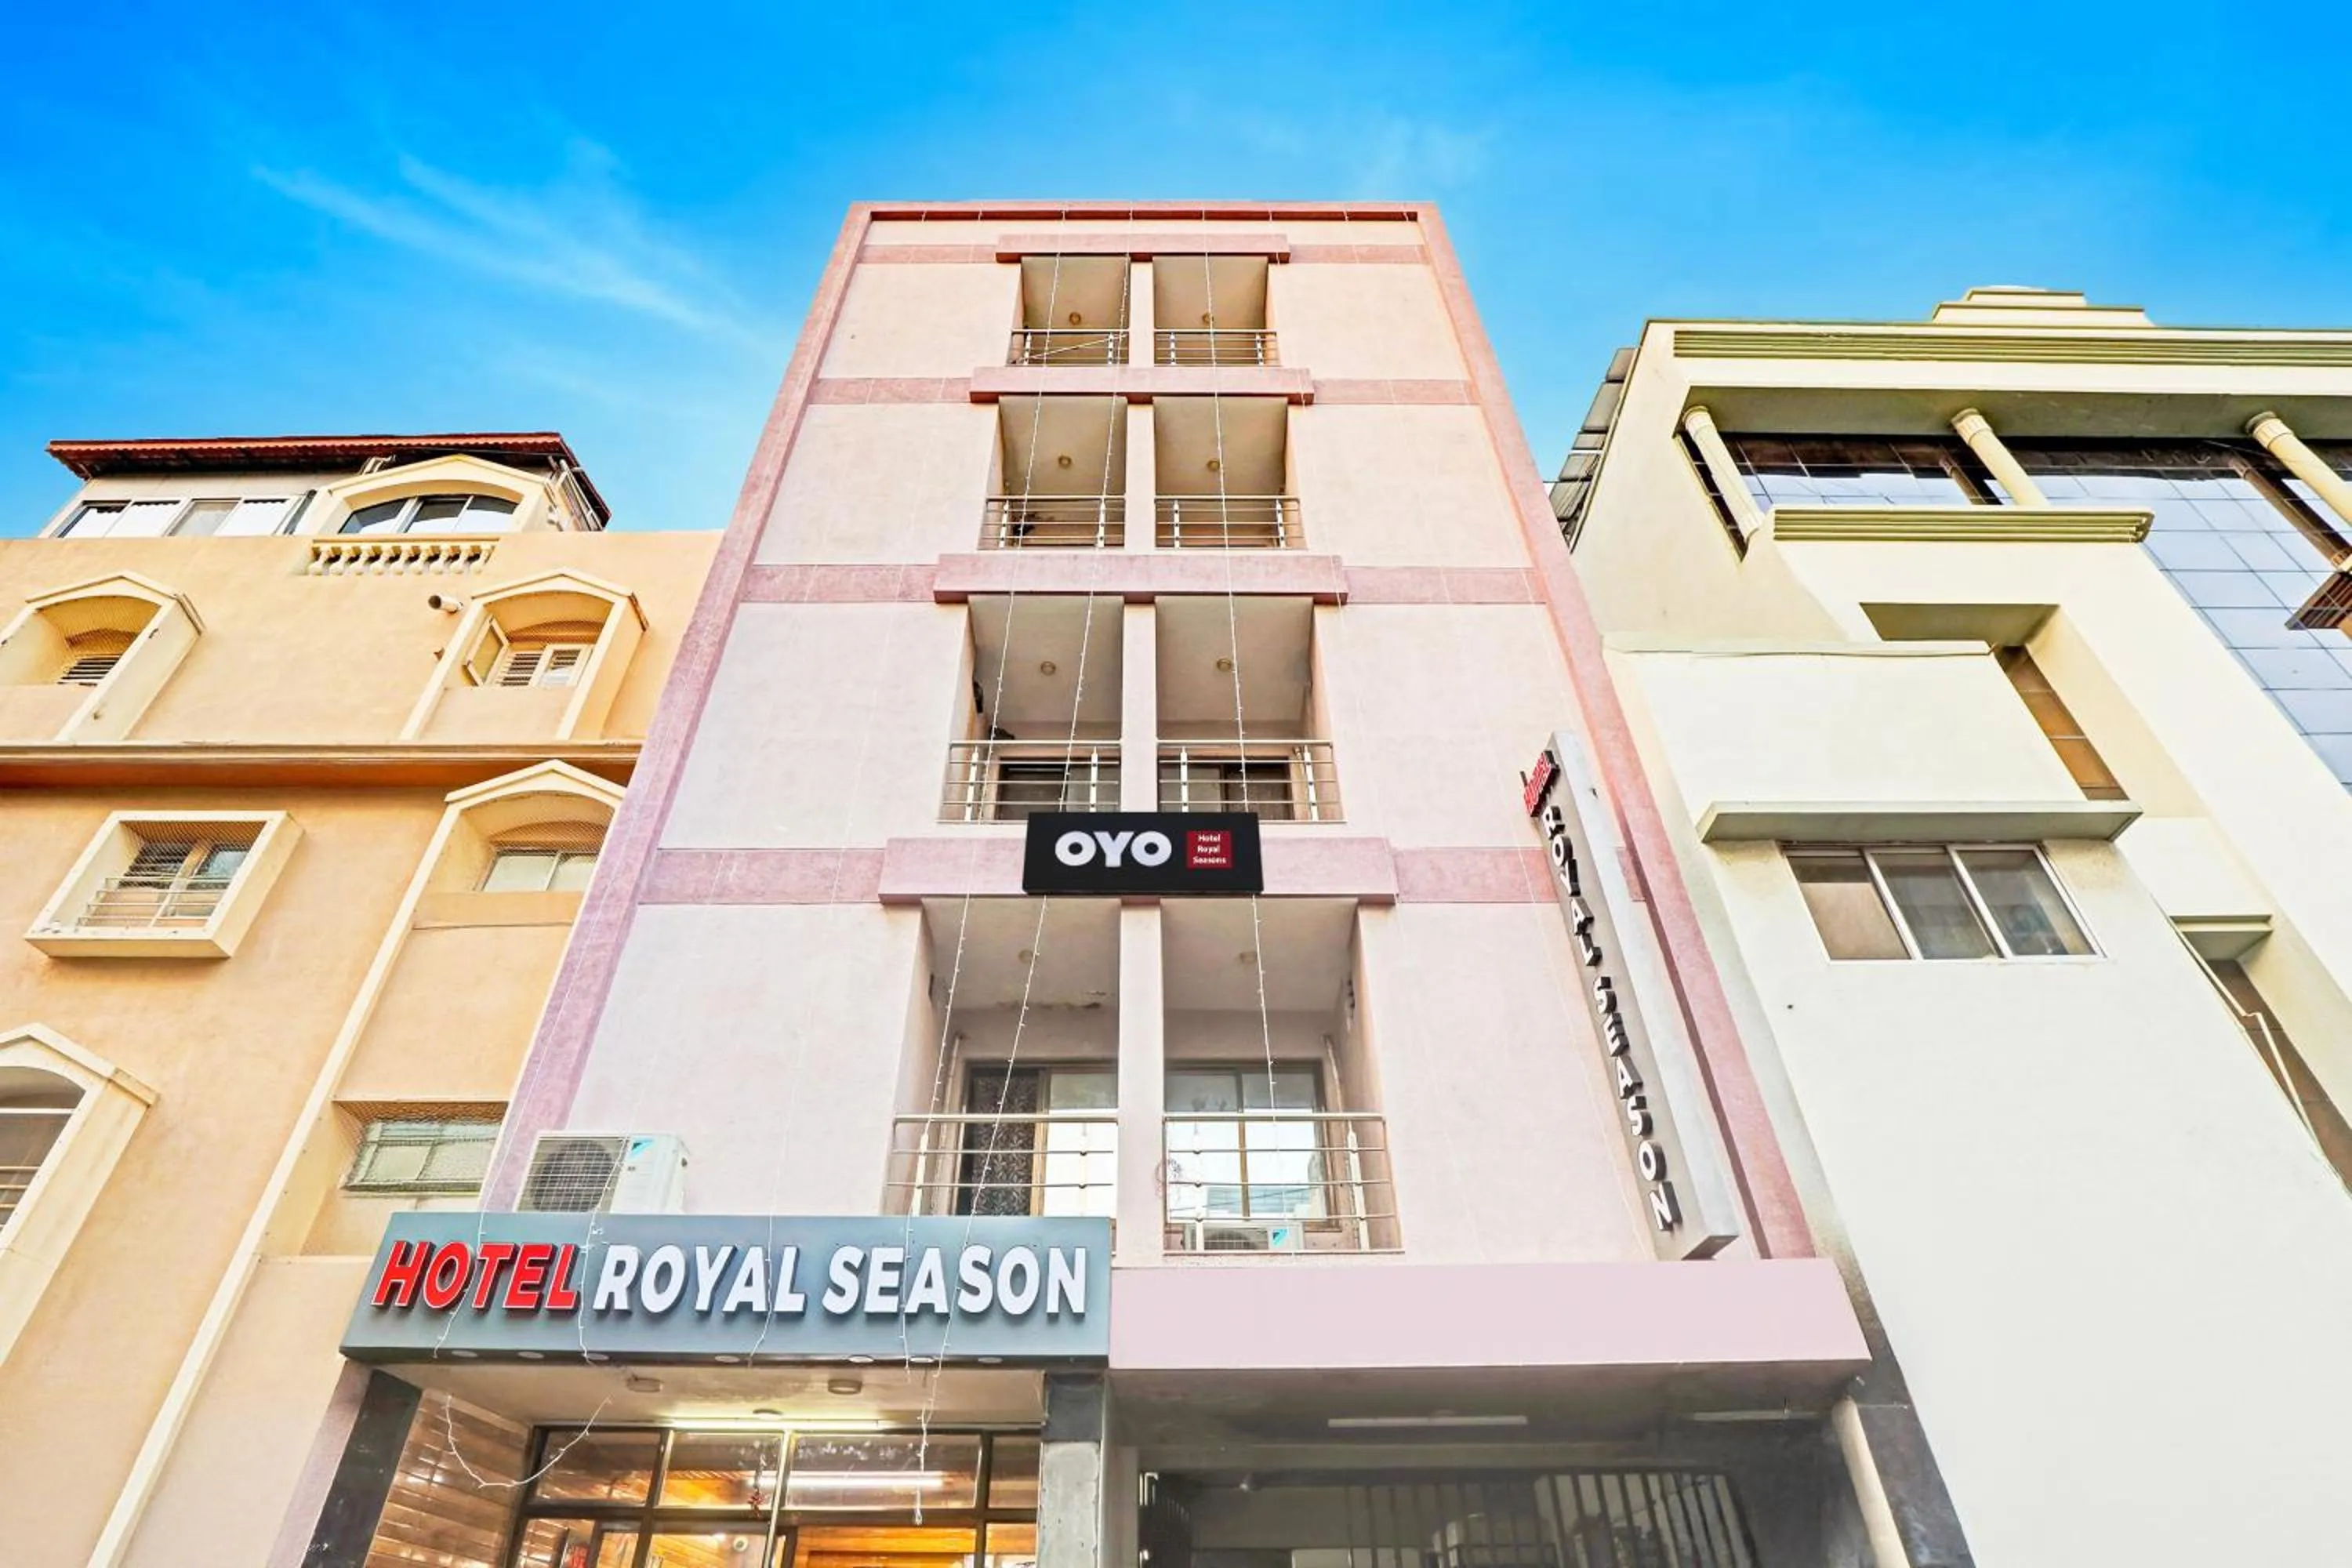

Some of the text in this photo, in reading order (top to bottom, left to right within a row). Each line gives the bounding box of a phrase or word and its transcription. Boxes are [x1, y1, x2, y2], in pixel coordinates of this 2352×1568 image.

[1054, 830, 1172, 867] OYO
[1197, 833, 1221, 842] Hotel
[1197, 844, 1220, 855] Royal
[1542, 805, 1601, 966] ROYAL
[1593, 976, 1681, 1231] SEASON
[371, 1241, 1087, 1316] HOTEL ROYAL SEASON
